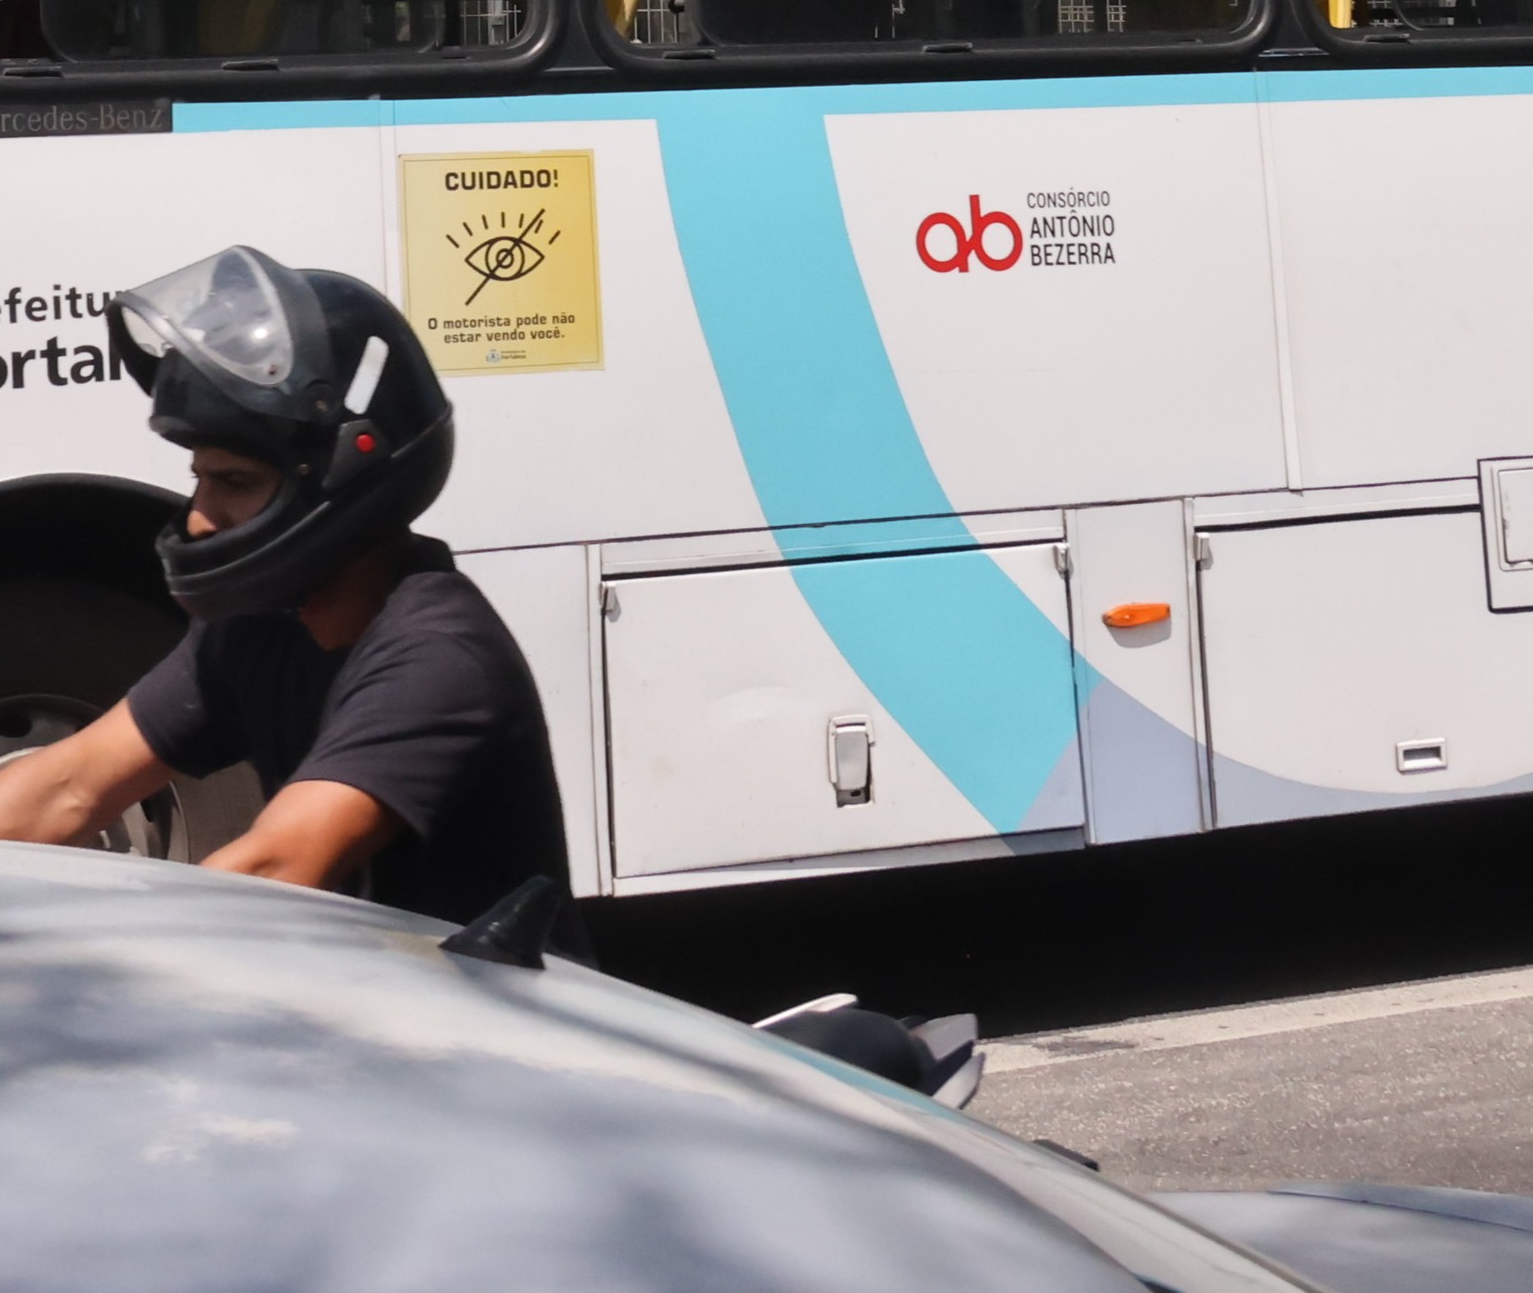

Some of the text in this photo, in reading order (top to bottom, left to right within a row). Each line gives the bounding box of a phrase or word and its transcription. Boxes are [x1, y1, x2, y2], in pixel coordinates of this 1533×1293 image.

[445, 169, 559, 191] CUIDADO!
[1027, 187, 1111, 209] CONSÓRCIO
[915, 194, 1024, 273] ab
[1029, 210, 1115, 238] ANTÔNIO
[1030, 242, 1116, 266] BEZERRA
[428, 311, 576, 330] O motorista pode não
[444, 326, 566, 344] estar vendo você.
